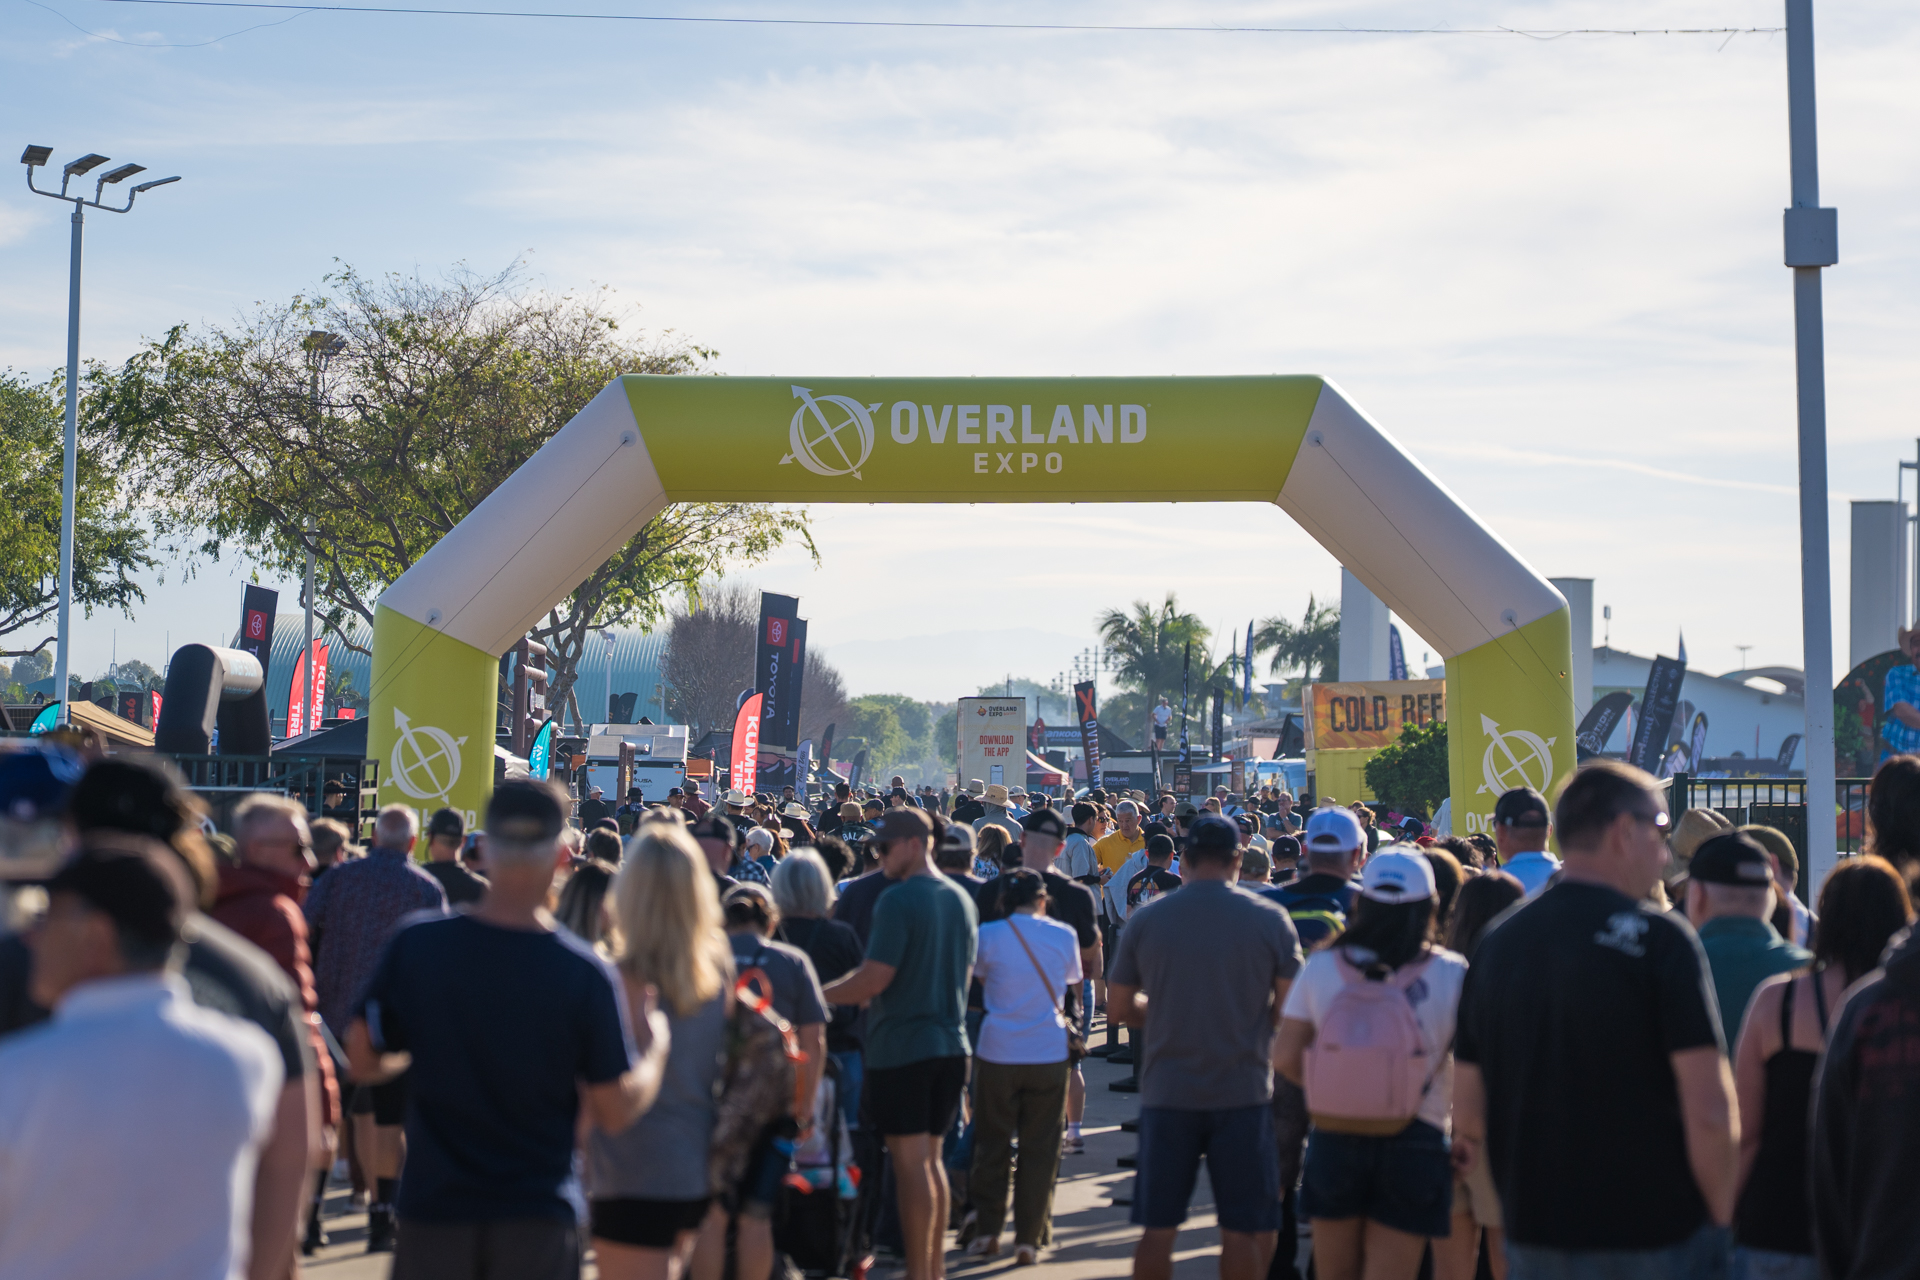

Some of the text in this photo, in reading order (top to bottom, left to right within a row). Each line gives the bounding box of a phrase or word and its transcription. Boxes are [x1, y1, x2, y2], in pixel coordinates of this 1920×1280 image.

[891, 401, 1147, 444] OVERLAND
[974, 452, 1063, 474] EXPO
[315, 665, 326, 727] KUMH
[765, 652, 780, 719] TOYOTA
[289, 701, 301, 738] TIRE
[1077, 688, 1097, 722] X
[1330, 695, 1389, 733] COLD
[979, 735, 1014, 745] DOWNLOAD
[1044, 730, 1083, 738] ankook
[984, 747, 1010, 757] THE APP
[733, 760, 743, 795] TIR
